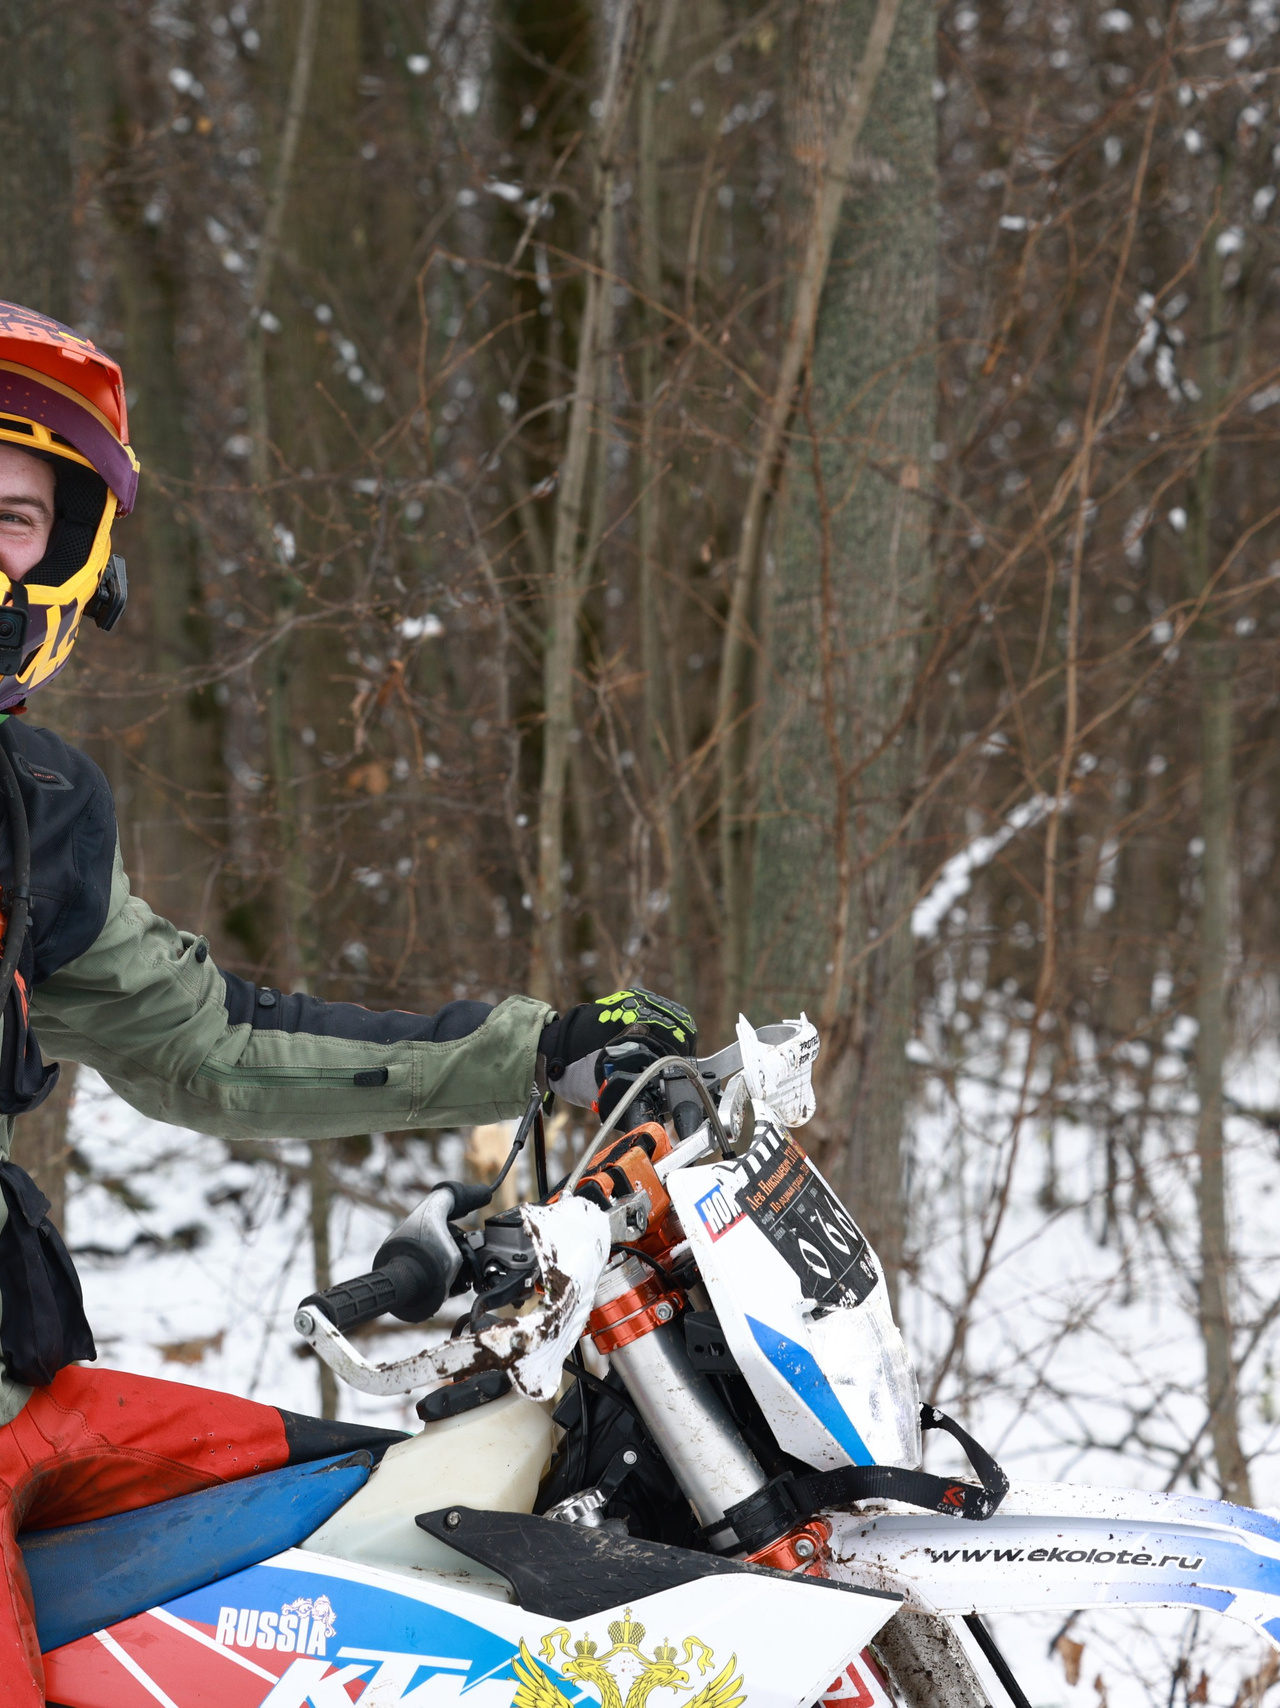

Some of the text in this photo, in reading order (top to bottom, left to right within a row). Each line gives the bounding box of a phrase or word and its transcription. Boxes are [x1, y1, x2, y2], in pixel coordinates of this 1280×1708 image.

[936, 1502, 967, 1519] CAKE
[929, 1546, 1204, 1571] www.ekolote.ru
[214, 1605, 328, 1657] RUSSIA
